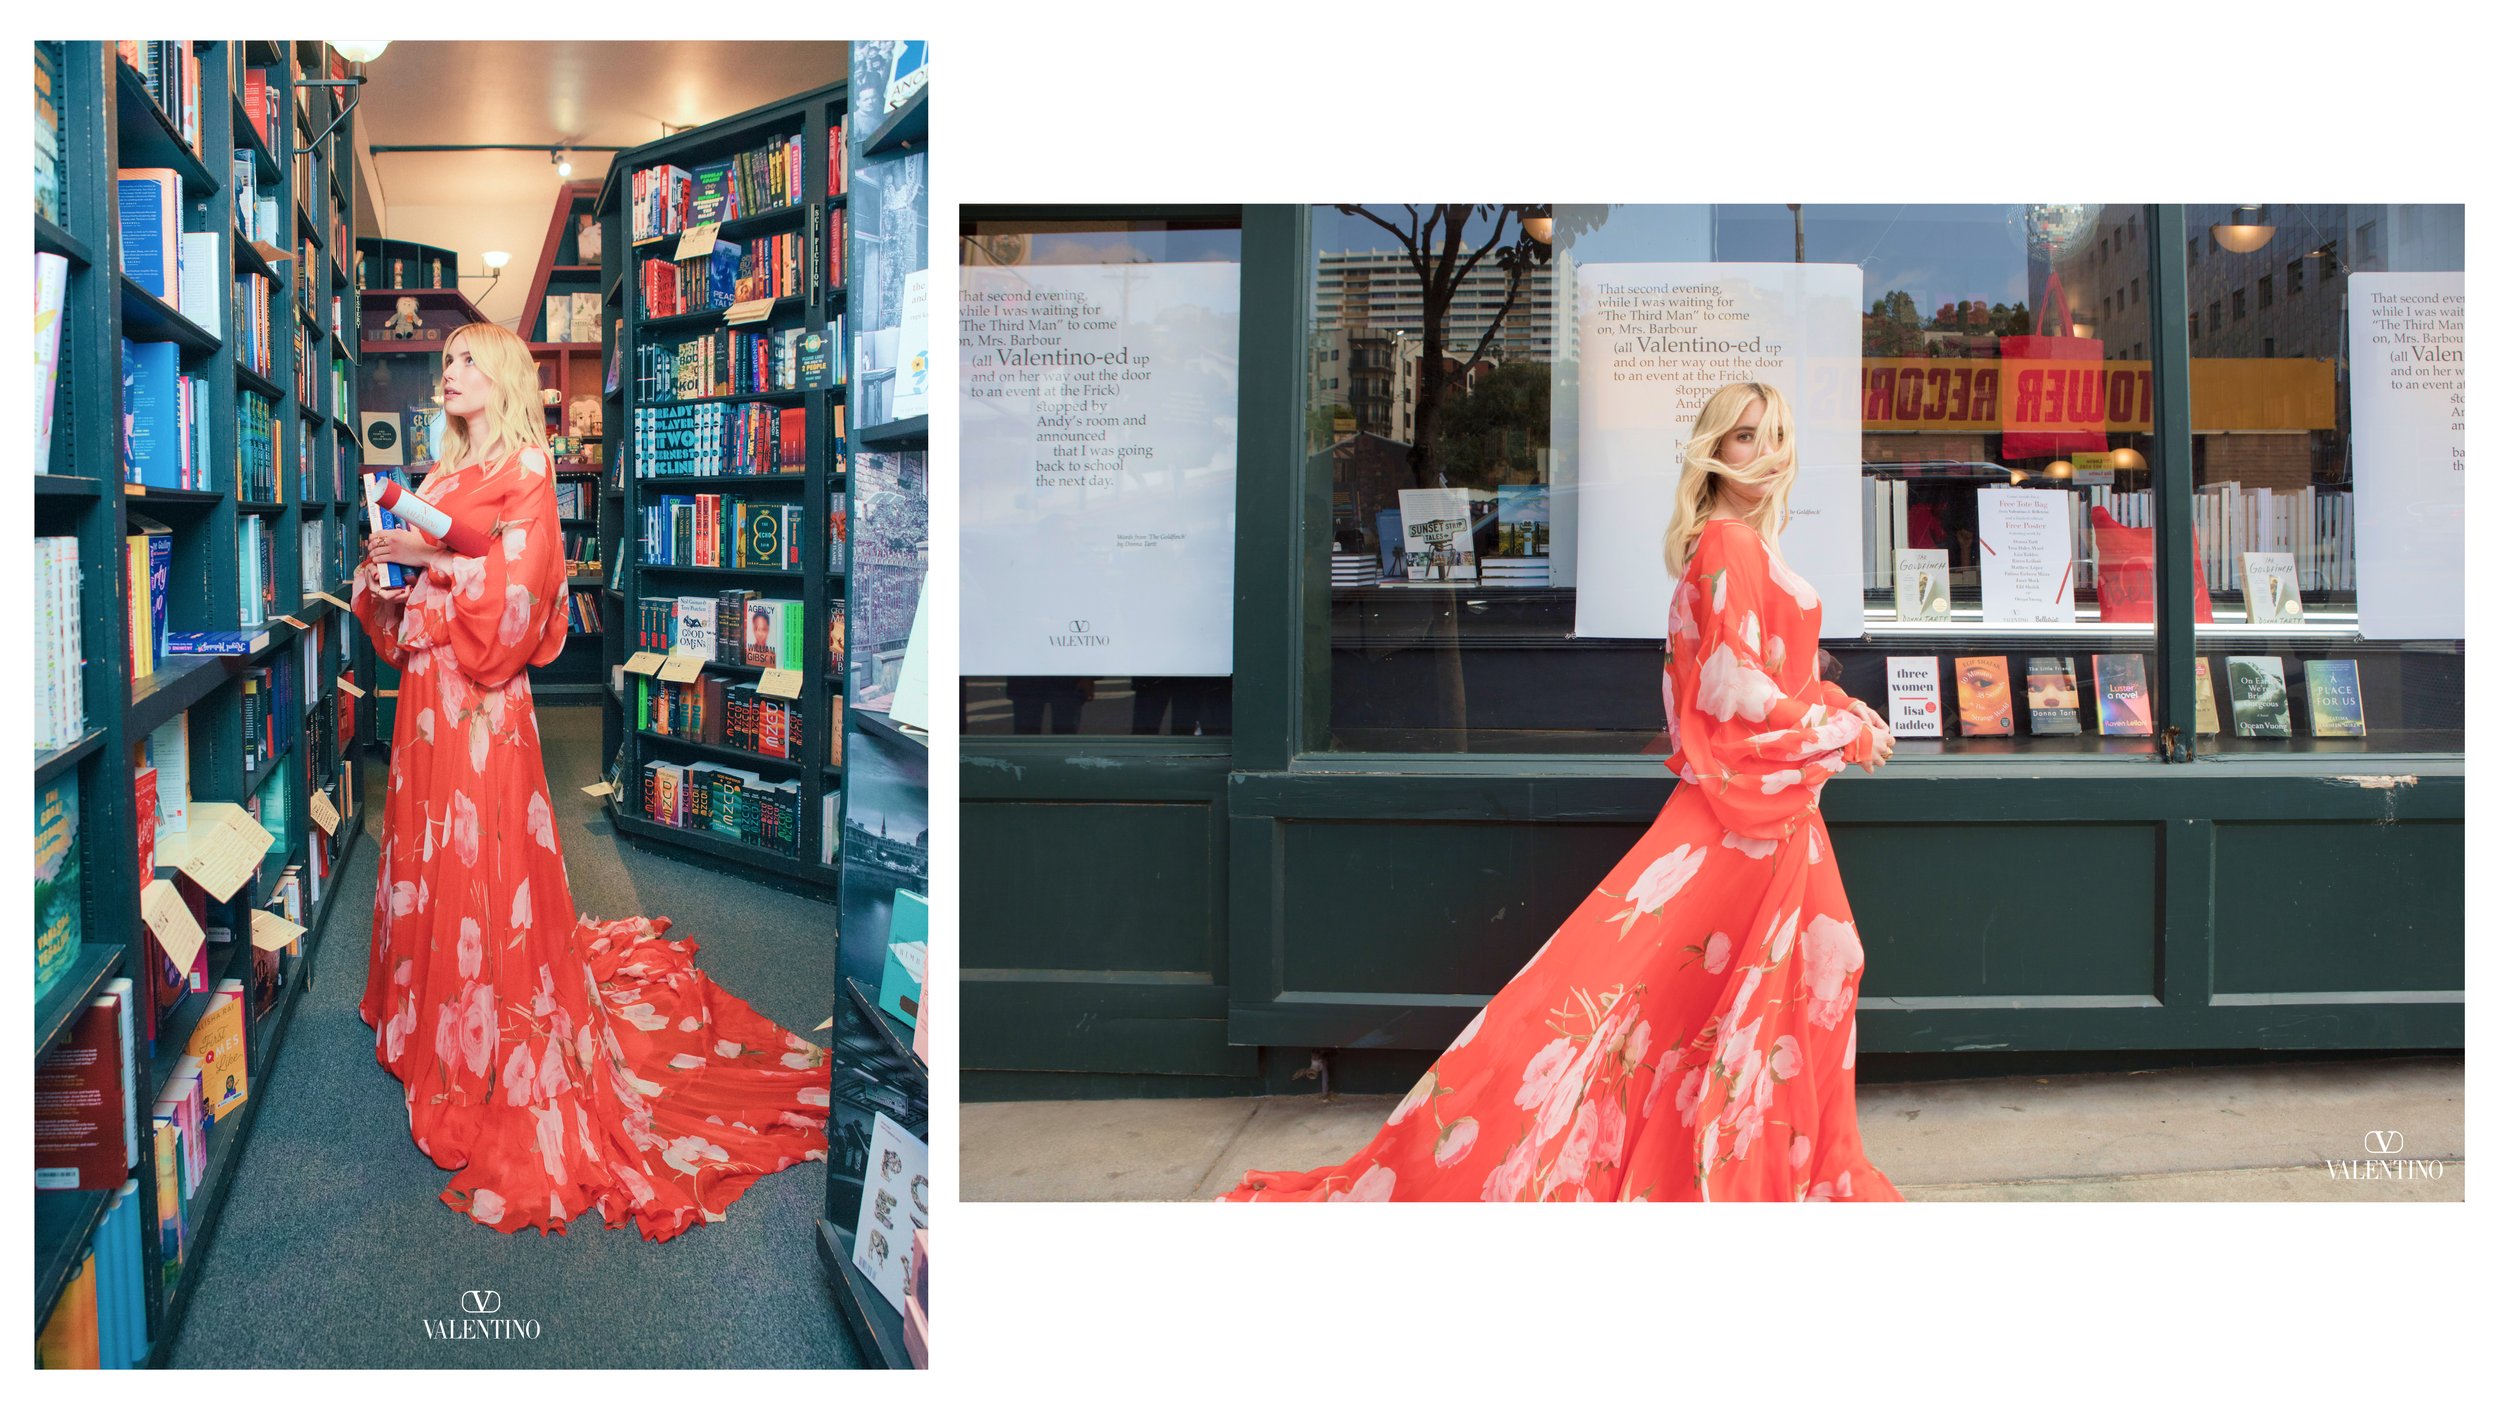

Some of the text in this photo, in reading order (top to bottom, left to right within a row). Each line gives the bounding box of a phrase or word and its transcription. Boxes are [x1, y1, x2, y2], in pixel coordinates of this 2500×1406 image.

[1598, 283, 1722, 296] That second evening,
[987, 290, 1088, 303] second evening,
[1598, 296, 1734, 309] while was waiting for
[2371, 293, 2439, 304] That second
[1002, 304, 1100, 318] was waiting for
[1630, 310, 1662, 320] Third
[2372, 306, 2437, 316] while was
[989, 319, 1117, 331] Third come
[1598, 324, 1697, 335] on, Mrs. Barbour
[2403, 320, 2434, 330] Third
[978, 334, 1061, 346] Mrs. Barbour
[2373, 334, 2419, 344] on, Mrs.
[1614, 336, 1781, 355] (all Valentino-ed up
[972, 348, 1150, 368] (all Valentino-ed up
[2391, 346, 2463, 363] (all Valen
[1614, 357, 1783, 370] and on her way out the door
[971, 369, 1151, 384] and on her way out the door
[1614, 370, 1754, 382] to an event the Frick)
[2391, 366, 2451, 376] and on her
[971, 384, 1120, 397] to event the Frick)
[2392, 380, 2453, 389] to an event
[656, 406, 693, 419] READY
[1037, 401, 1107, 415] stopped by
[660, 418, 694, 430] PLAYER
[1037, 415, 1146, 430] Andy’s room and
[661, 430, 694, 448] TWO
[1037, 430, 1106, 442] announced
[661, 449, 694, 460] ERNEST
[1054, 445, 1153, 459] that was going
[1036, 460, 1123, 472] back school
[1036, 475, 1114, 488] the next day.
[1411, 522, 1463, 535] SUNSET STRIP
[1425, 533, 1443, 541] TALES
[1900, 560, 1946, 570] GOLDFINCH
[2250, 562, 2292, 573] GOLDFINCH
[748, 605, 774, 614] AGENCY
[682, 629, 704, 638] GOOD
[1050, 635, 1110, 647] VALENTINO
[748, 643, 775, 654] WILLIAM
[747, 653, 775, 665] GIBSON
[1897, 669, 1928, 679] three
[1892, 683, 1933, 691] women
[2110, 684, 2134, 692] Luster
[2318, 686, 2351, 694] PLACE
[2116, 691, 2137, 699] novel
[2316, 697, 2356, 706] FOR US
[1904, 706, 1924, 716] lisa
[766, 702, 779, 748] DUNE
[1896, 720, 1934, 730] taddeo
[2264, 722, 2287, 732] Vuong
[723, 783, 734, 826] DUNE
[223, 1004, 234, 1014] RAI
